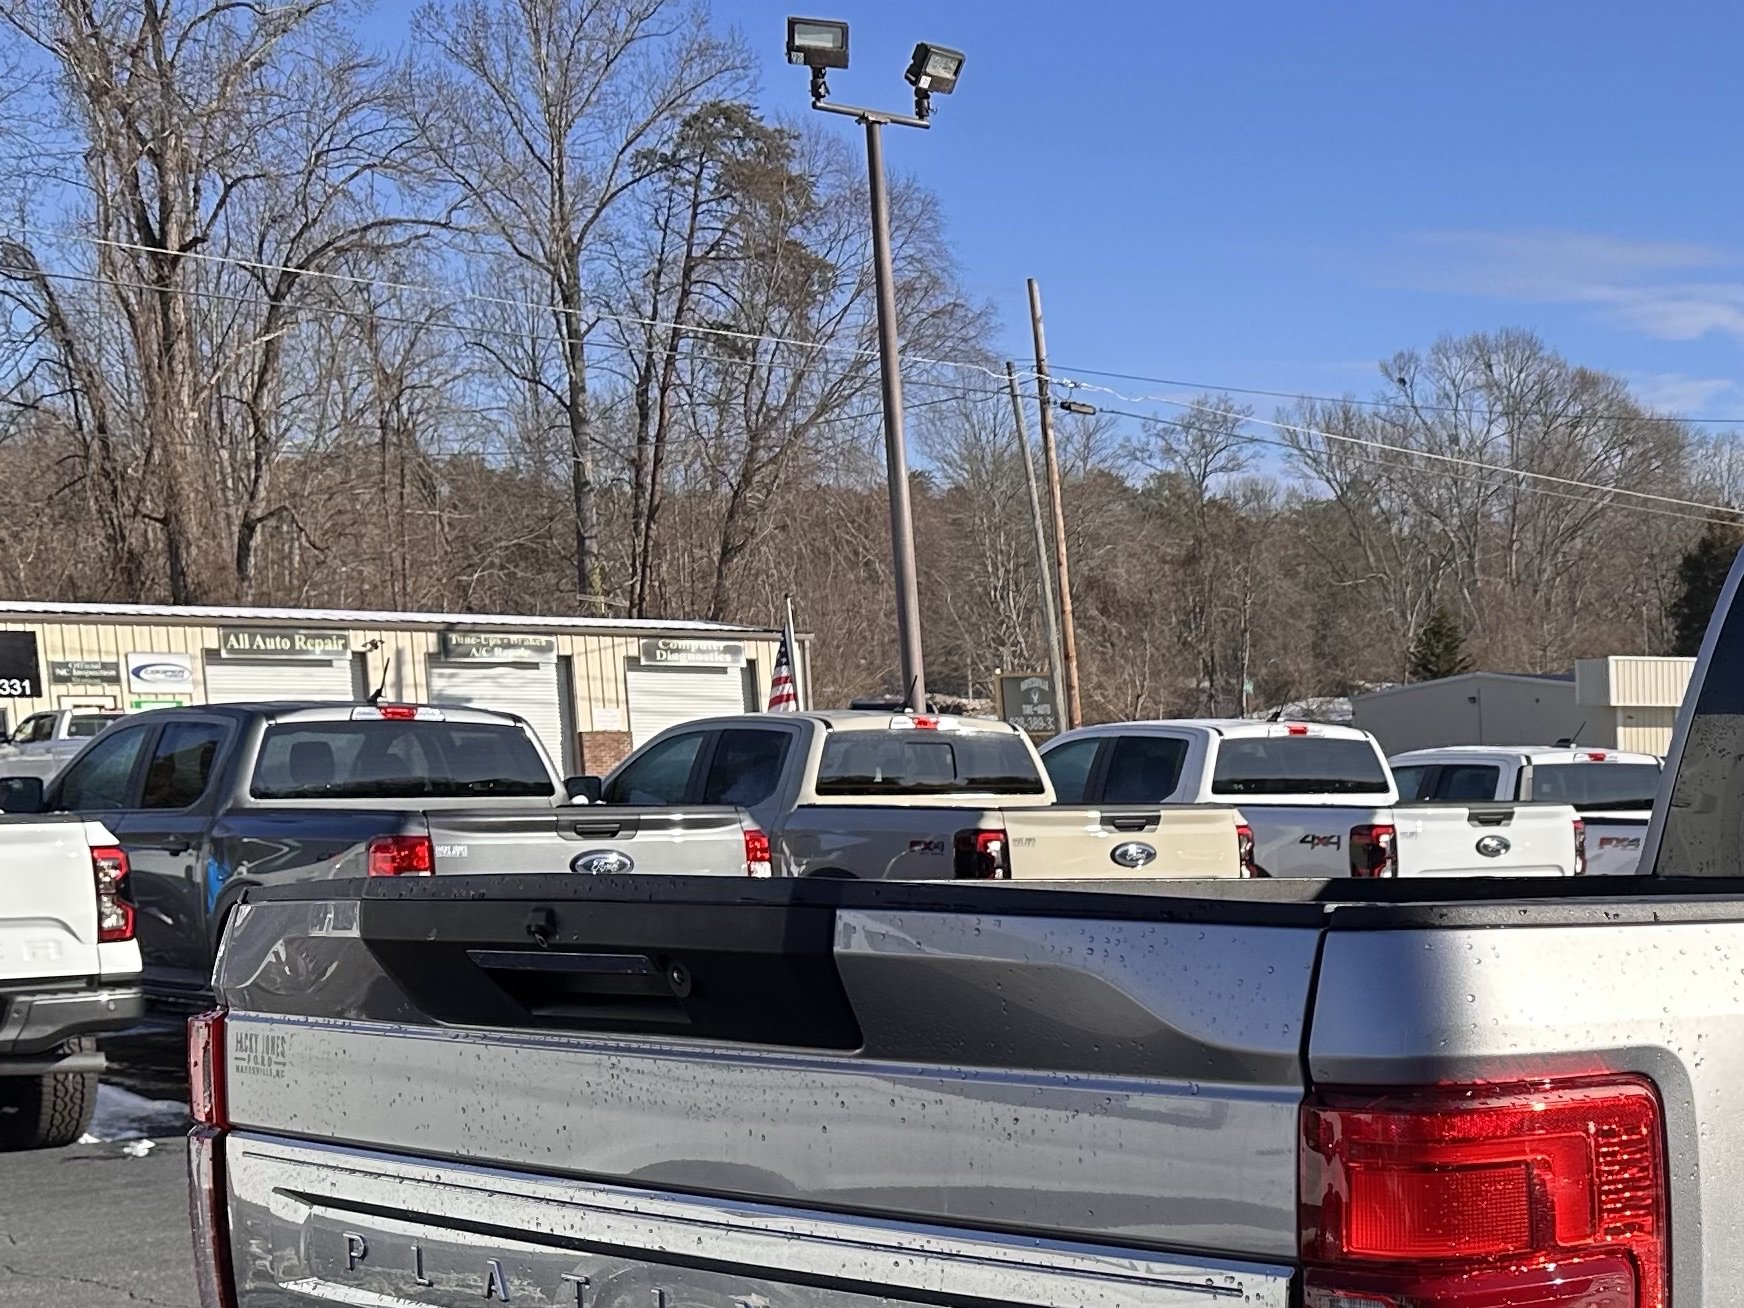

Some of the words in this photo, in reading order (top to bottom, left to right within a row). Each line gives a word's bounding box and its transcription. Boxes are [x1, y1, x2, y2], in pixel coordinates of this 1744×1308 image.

[226, 633, 250, 649] All
[253, 634, 291, 650] Auto
[294, 634, 346, 655] Repair
[658, 639, 724, 653] Computer
[469, 647, 492, 657] A/C
[909, 840, 944, 852] FX4
[1599, 837, 1641, 849] FX4
